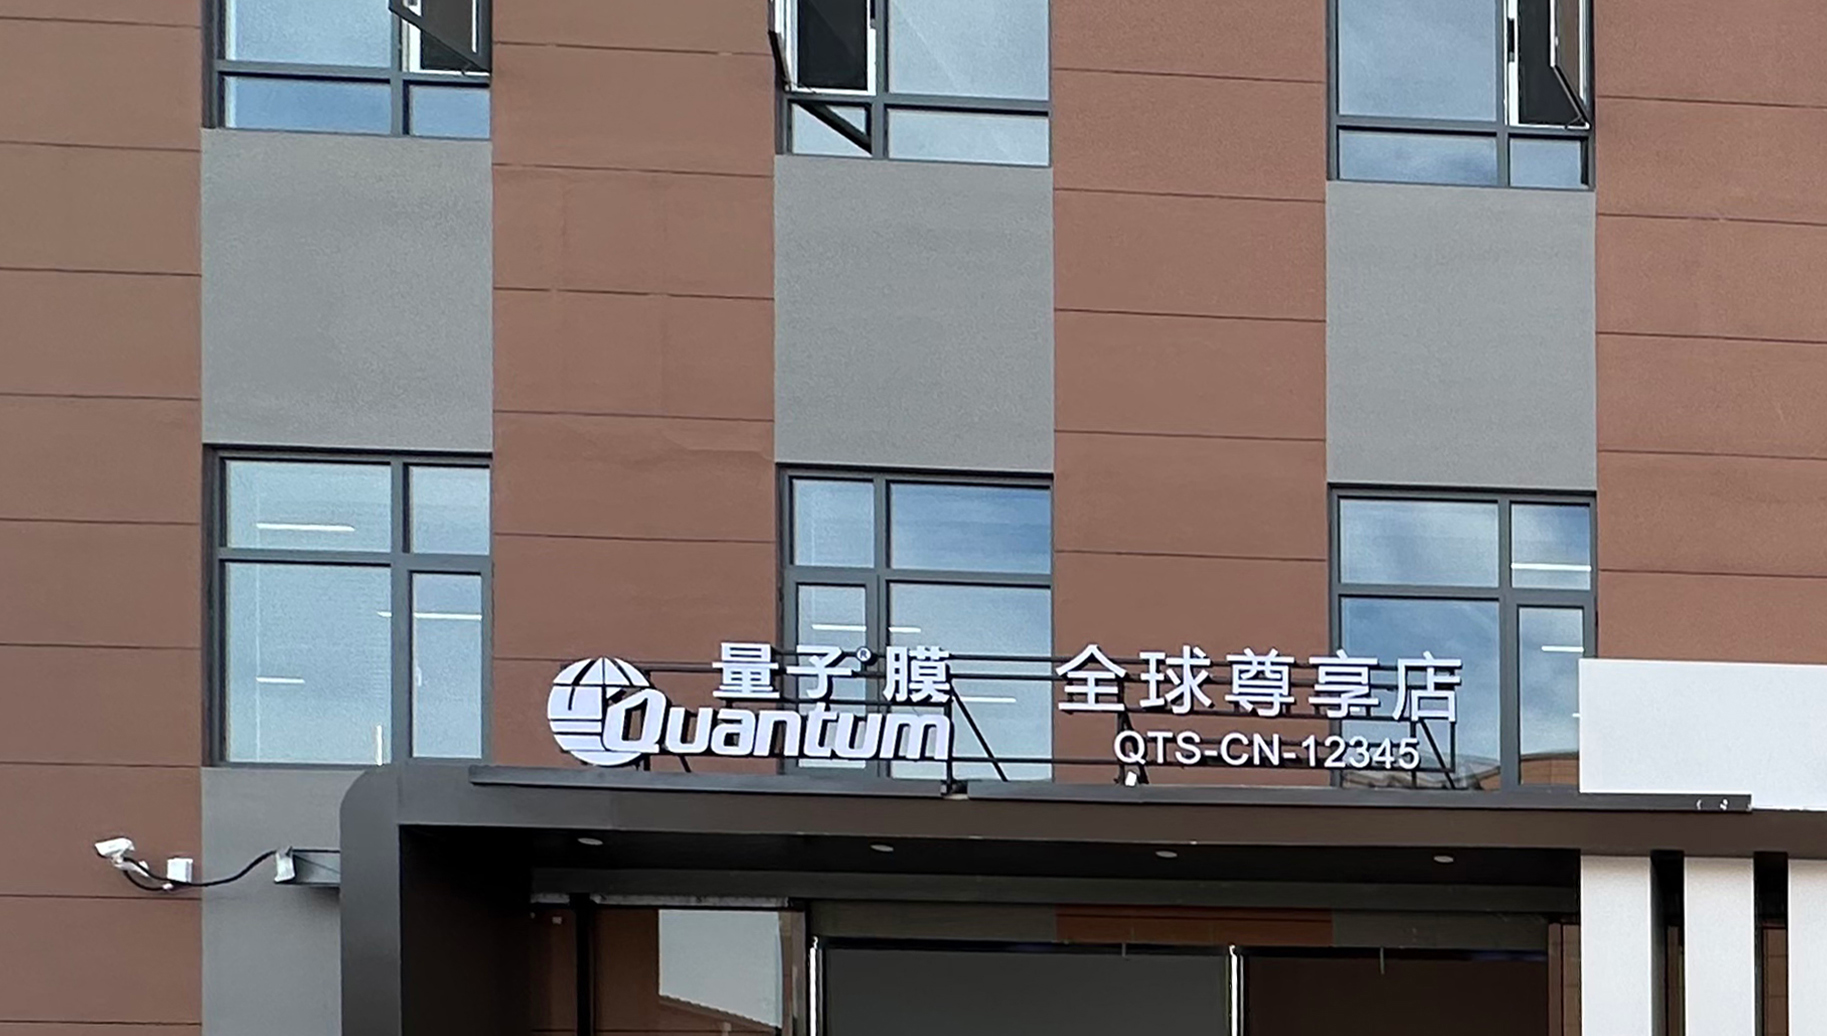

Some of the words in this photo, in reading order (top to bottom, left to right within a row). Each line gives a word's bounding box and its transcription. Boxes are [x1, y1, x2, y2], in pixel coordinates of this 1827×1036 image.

[1055, 643, 1463, 723] 全球尊享店
[602, 687, 951, 761] Quantum
[1113, 729, 1421, 770] QTS-CN-12345
